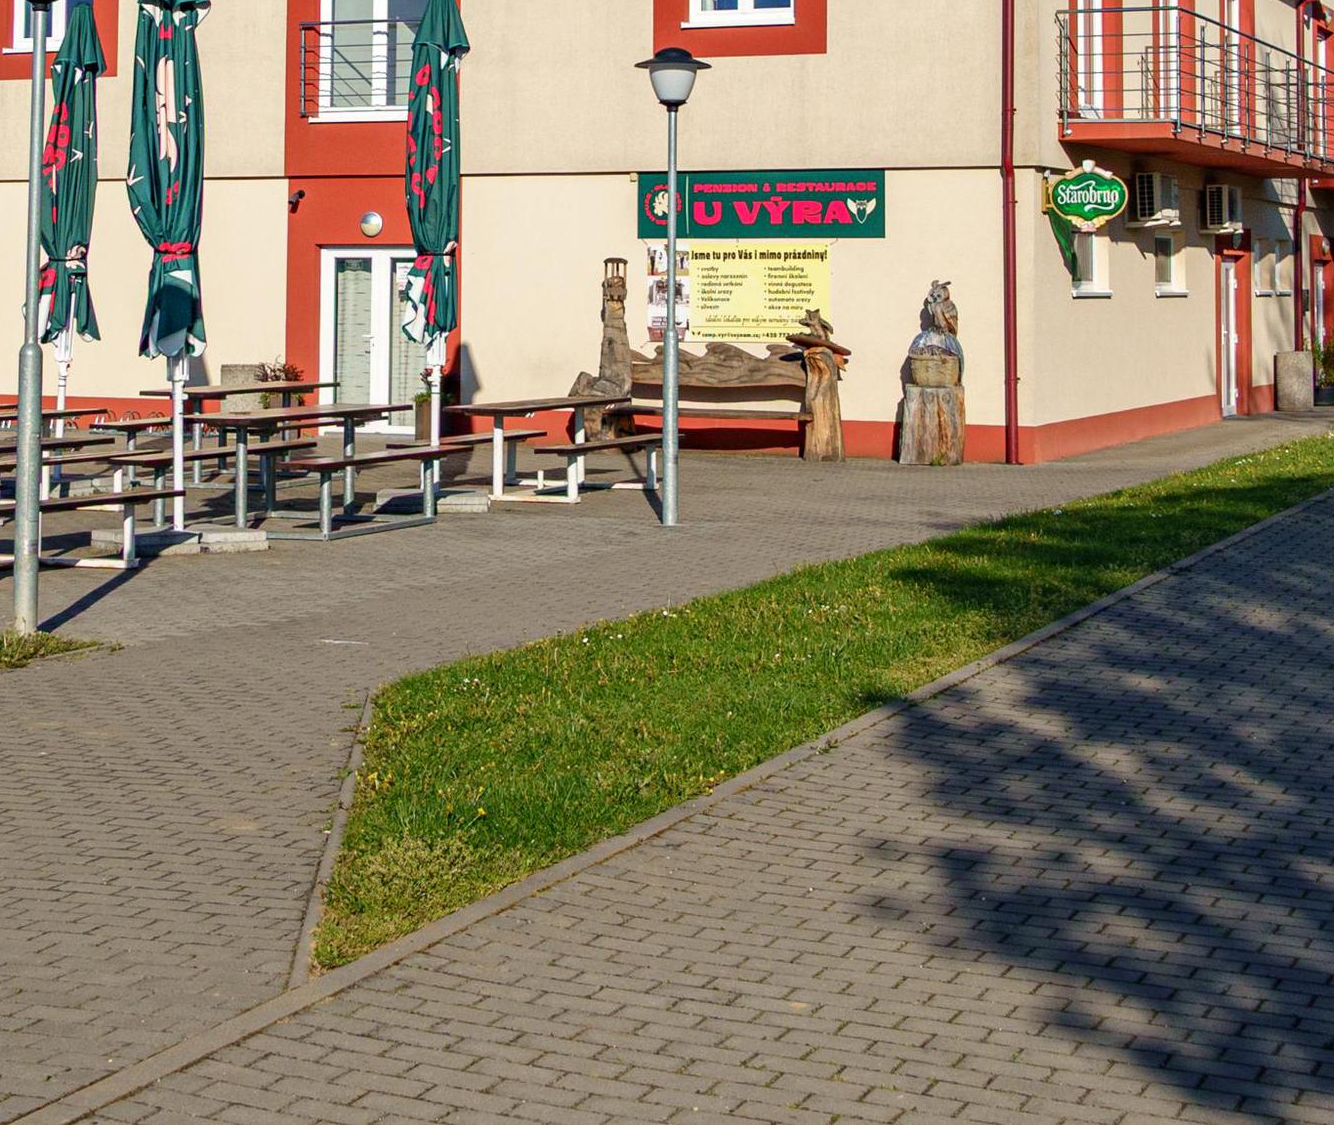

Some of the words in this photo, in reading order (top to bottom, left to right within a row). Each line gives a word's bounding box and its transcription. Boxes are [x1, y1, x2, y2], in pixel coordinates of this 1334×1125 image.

[693, 183, 757, 193] PENZION
[763, 183, 771, 192] &
[776, 181, 876, 193] RESTAURACE
[1057, 180, 1119, 211] Starobrno
[693, 201, 722, 225] U
[733, 196, 853, 225] VÝRA
[691, 250, 710, 260] Jsme
[712, 251, 721, 260] tu
[723, 252, 736, 262] pro
[738, 249, 753, 260] Vás
[759, 249, 782, 260] mimo
[784, 249, 828, 262] prázdniny!
